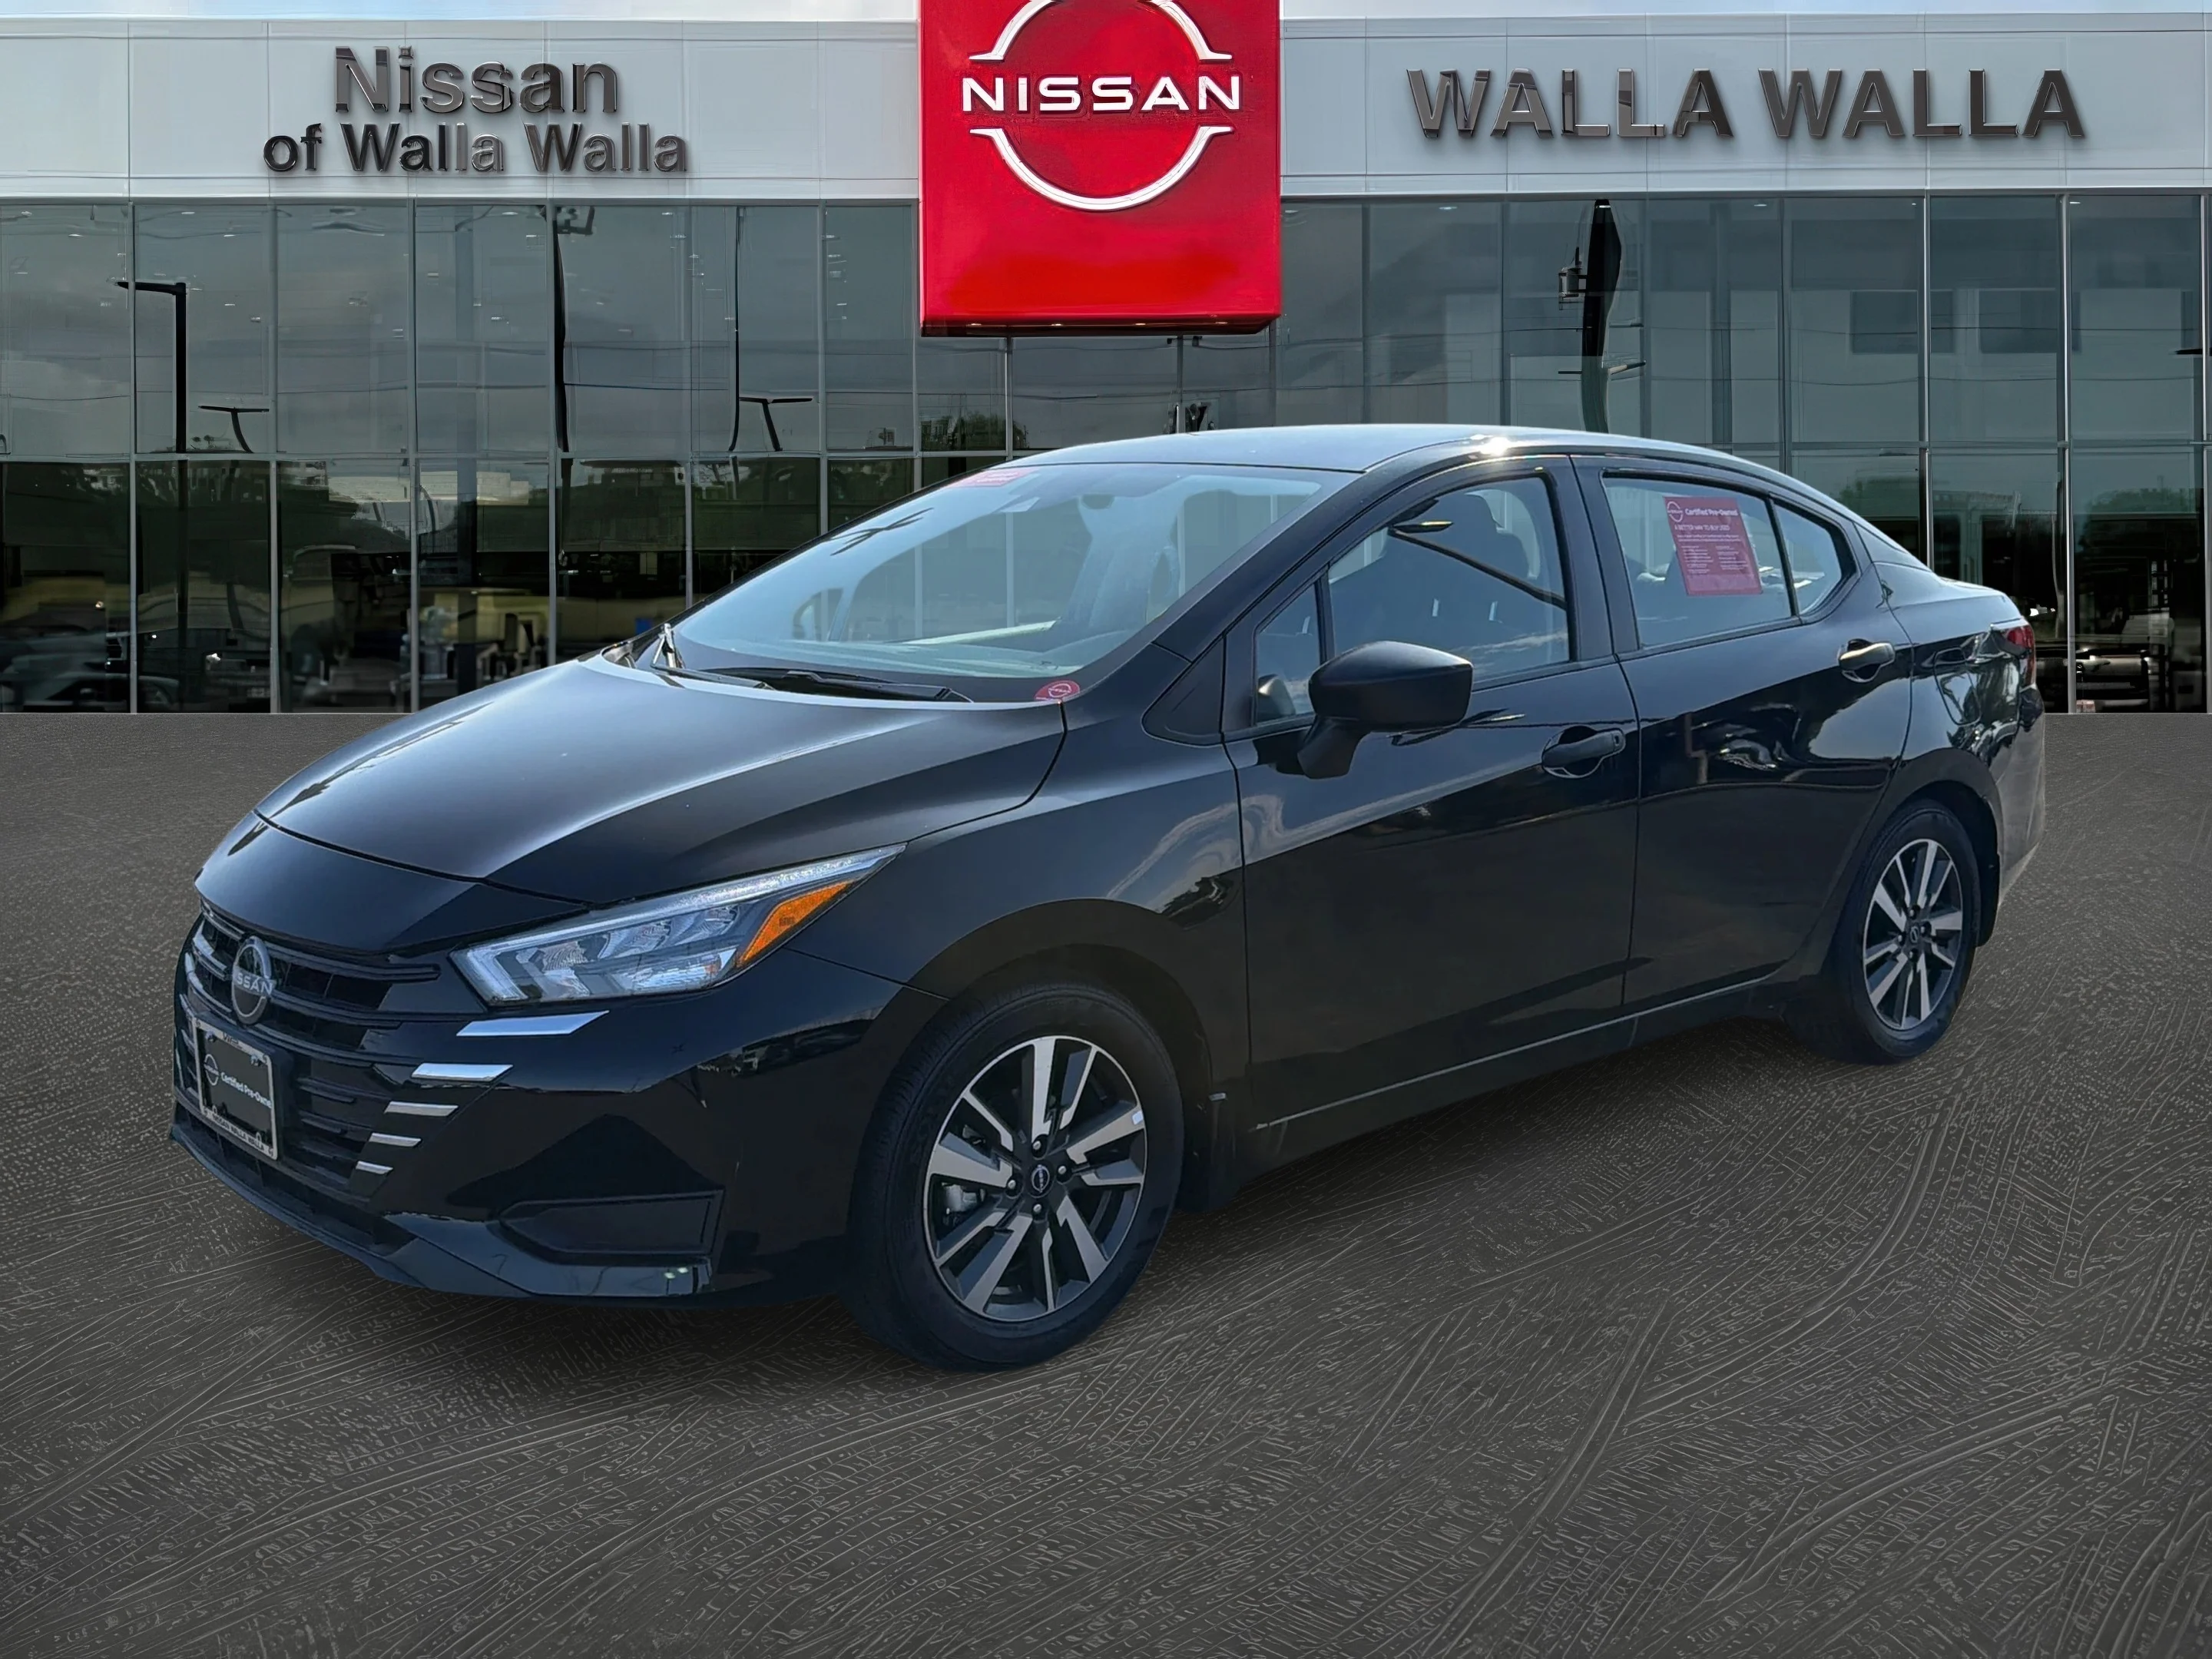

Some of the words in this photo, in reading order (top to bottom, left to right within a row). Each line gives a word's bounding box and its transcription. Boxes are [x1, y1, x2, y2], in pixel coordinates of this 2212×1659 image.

[335, 45, 618, 113] Nissan
[962, 75, 1240, 112] NISSAN
[1406, 68, 1734, 138] WALLA
[1758, 68, 2087, 138] WALLA
[263, 123, 323, 172] of
[339, 122, 504, 173] Walla
[523, 121, 688, 173] Walla
[1684, 508, 1708, 516] Certified
[220, 1071, 244, 1093] Certified
[243, 1084, 273, 1109] Pre-Owne
